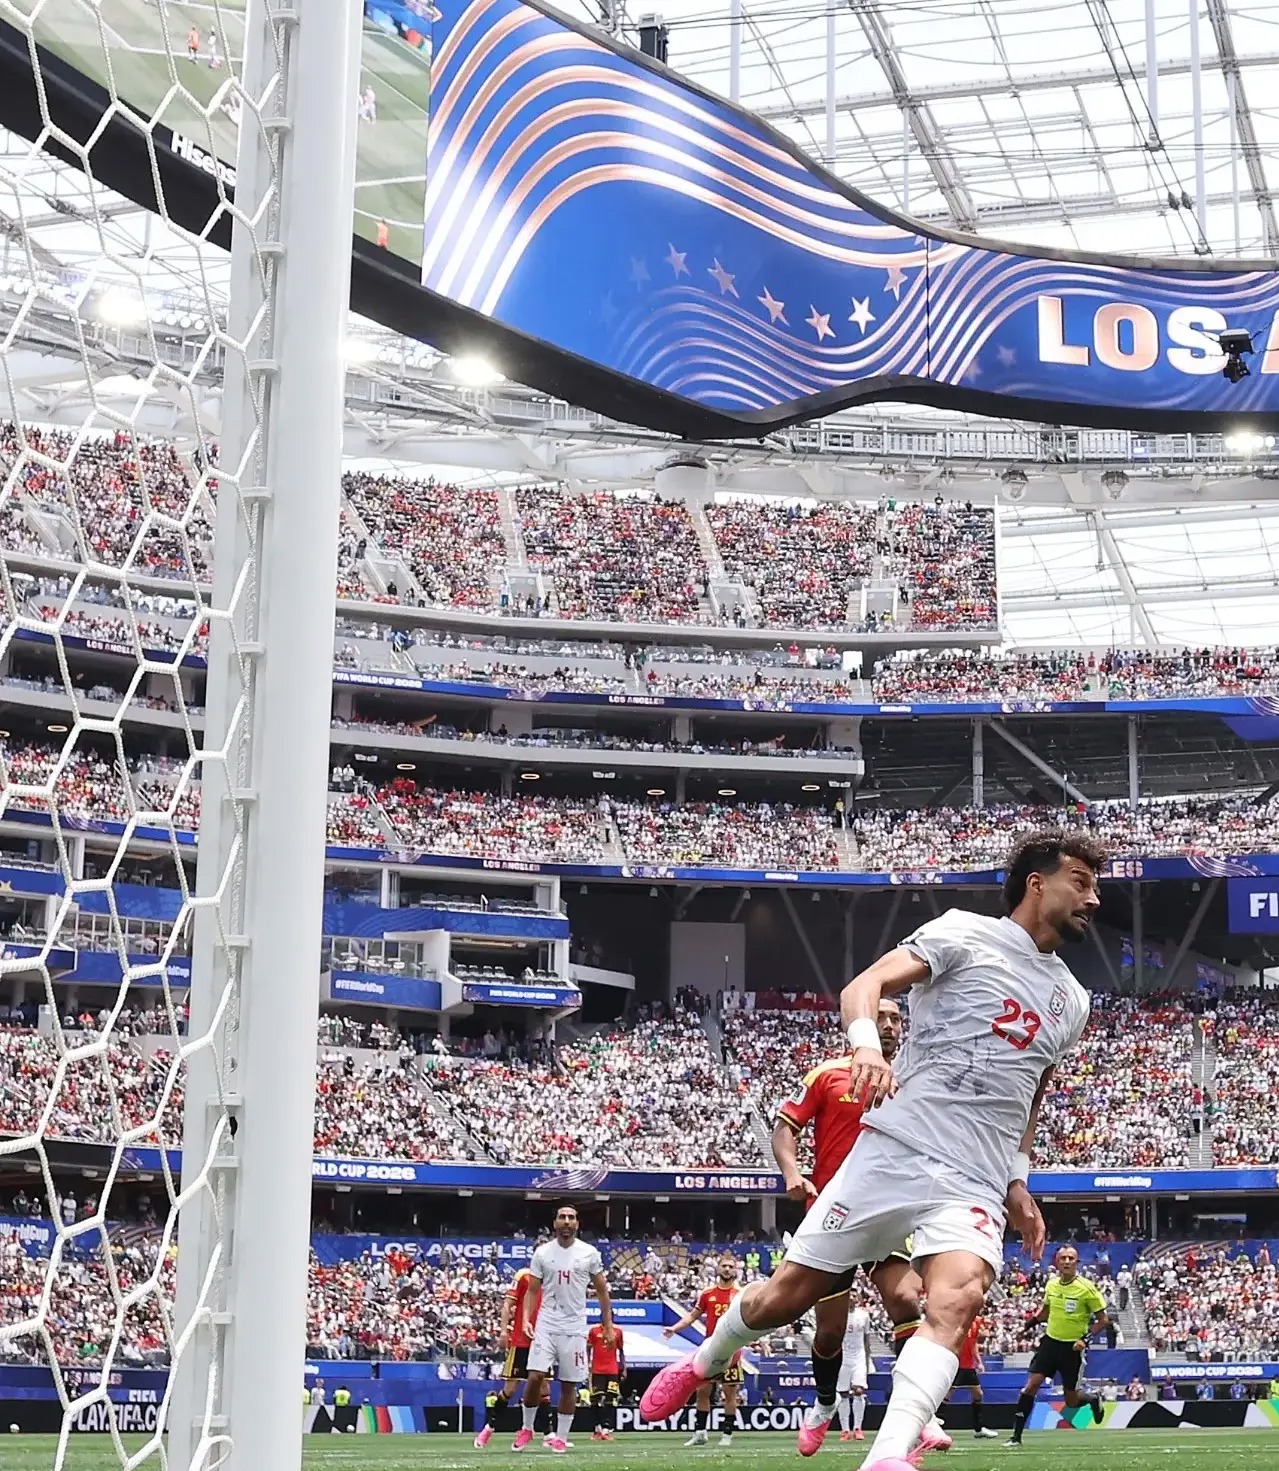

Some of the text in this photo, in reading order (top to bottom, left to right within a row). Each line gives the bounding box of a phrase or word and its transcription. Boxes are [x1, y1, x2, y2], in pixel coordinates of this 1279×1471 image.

[171, 132, 236, 187] Hisens
[1037, 295, 1228, 374] LOS
[350, 674, 379, 684] WORLD
[379, 676, 395, 686] CUP
[395, 678, 422, 688] 2026
[608, 695, 626, 704] LOS
[483, 859, 501, 869] LOS
[992, 999, 1041, 1050] 23
[312, 1163, 416, 1181] RLD CUP 2026
[675, 1175, 778, 1190] LOS ANGELES
[371, 1242, 418, 1259] LOS
[557, 1270, 570, 1285] 14
[724, 1368, 740, 1381] 23
[1168, 1367, 1206, 1377] WORLD
[1206, 1367, 1227, 1376] CUP
[1227, 1366, 1263, 1376] 2026
[779, 1376, 801, 1387] LOS
